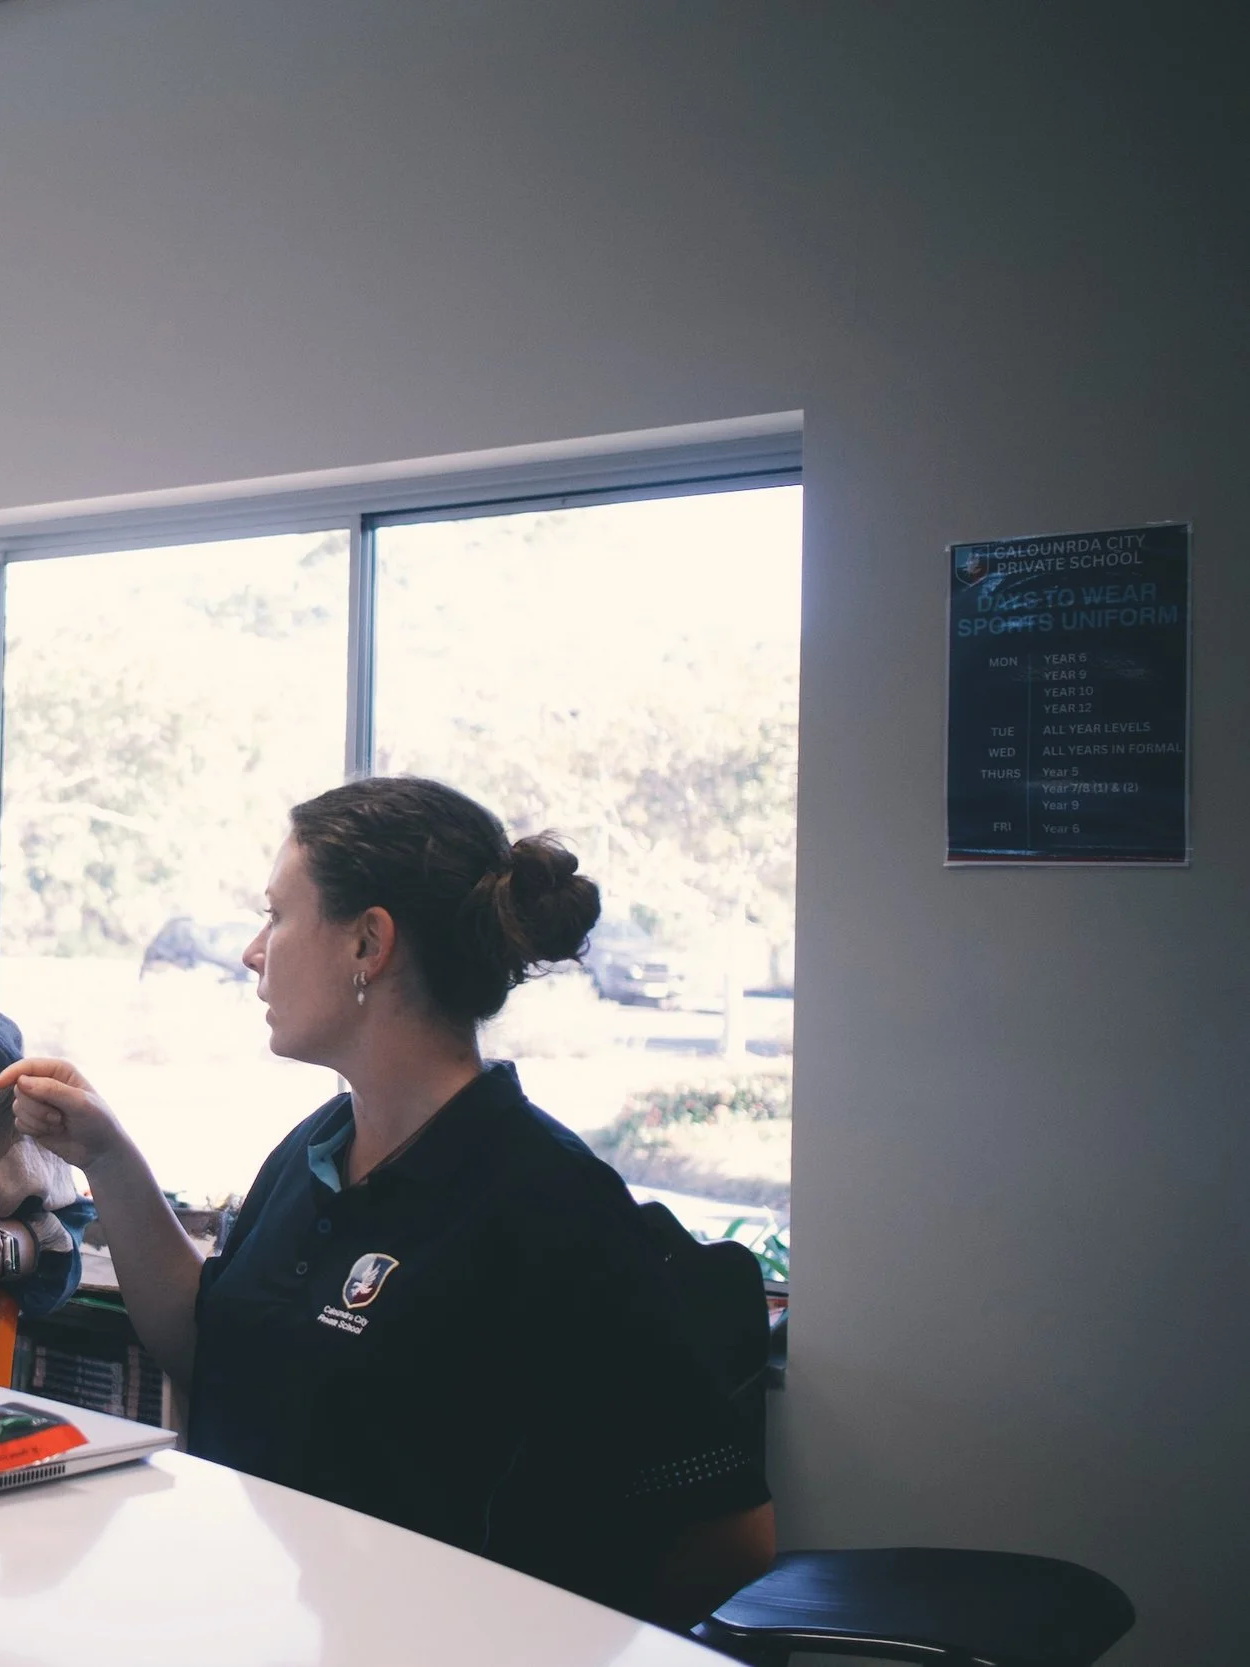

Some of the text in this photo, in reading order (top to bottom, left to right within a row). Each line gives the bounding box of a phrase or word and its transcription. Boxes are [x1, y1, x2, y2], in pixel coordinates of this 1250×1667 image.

[1106, 534, 1146, 550] CITY
[997, 551, 1143, 575] PRIVATE SCHOOL
[1044, 587, 1076, 608] TO
[1081, 582, 1157, 605] WEAR
[1061, 605, 1178, 631] UNIFORM
[989, 656, 1019, 668] MON
[1043, 653, 1088, 665] YEAR 6
[1044, 669, 1088, 681] YEAR 9
[1044, 685, 1094, 698] YEAR 10
[1044, 702, 1093, 714] YEAR 12
[991, 726, 1015, 737] TUE
[1042, 721, 1151, 736] ALL YEAR LEVELS
[988, 747, 1016, 758] WED
[1042, 741, 1184, 757] ALL YEARS IN FORMAL
[981, 768, 1022, 780] THURS
[1042, 766, 1080, 778] Year 5
[1042, 783, 1069, 794] Year
[1111, 783, 1120, 793] &
[1123, 782, 1139, 793] (2)
[1042, 799, 1080, 811] Year 9
[993, 821, 1012, 832] FRI
[1042, 823, 1081, 834] Year 6
